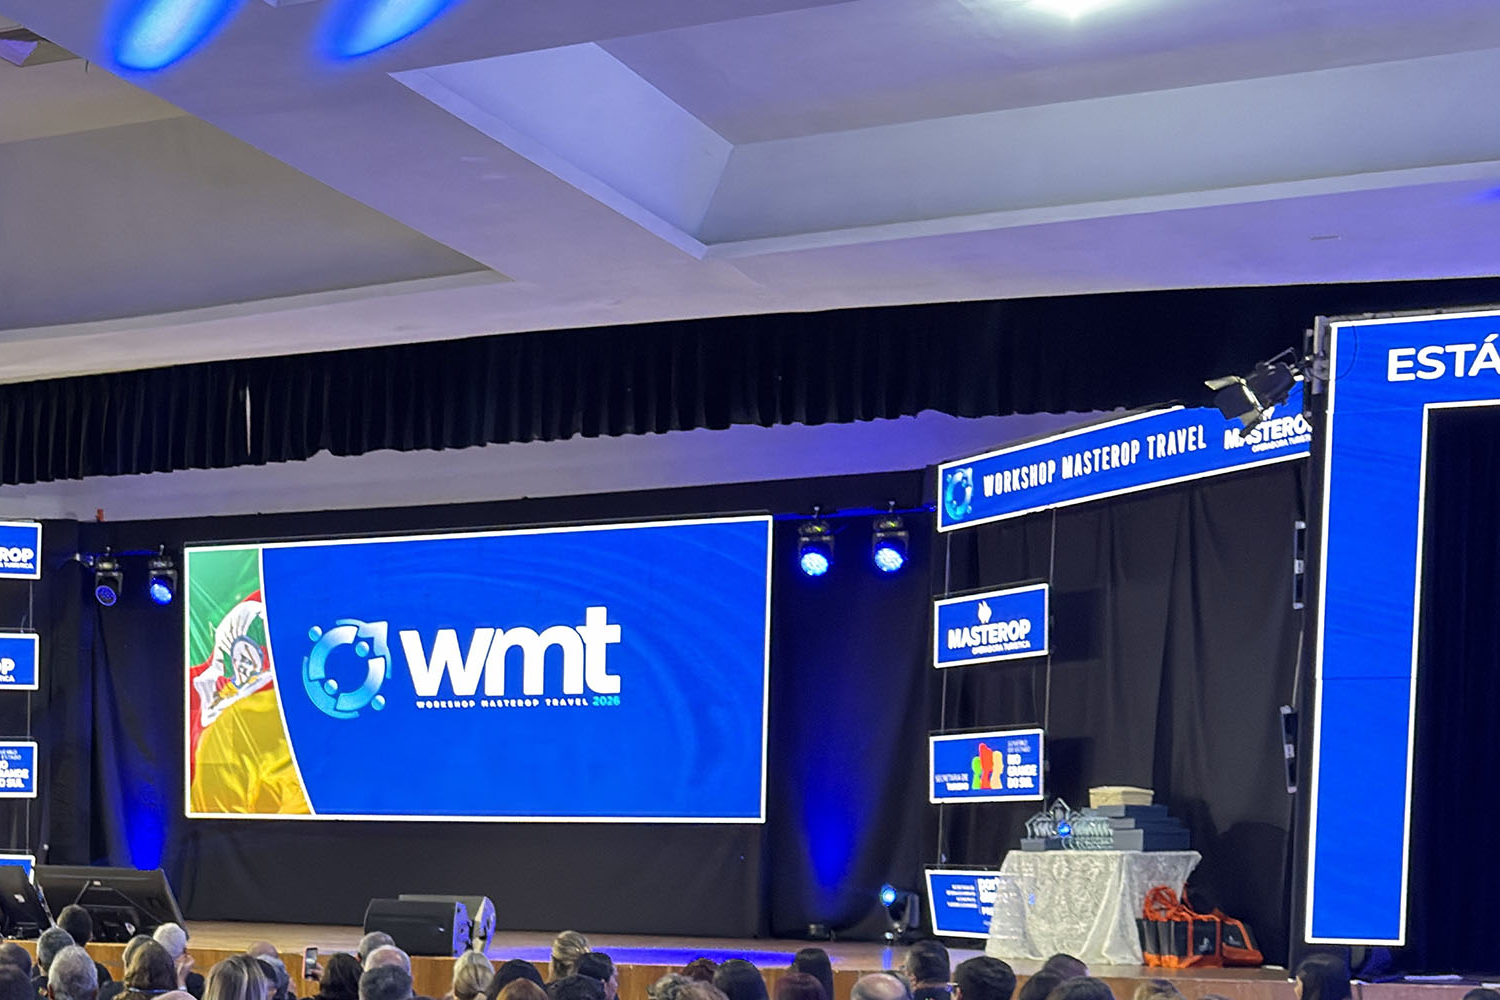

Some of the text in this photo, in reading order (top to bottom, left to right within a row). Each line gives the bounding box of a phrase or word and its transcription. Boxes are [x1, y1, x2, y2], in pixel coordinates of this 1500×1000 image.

[1387, 333, 1500, 382] ESTÁ
[1223, 413, 1312, 450] MSTERO
[983, 424, 1207, 498] WORKSHOP MASTEROP TRAVEL
[399, 606, 622, 697] wmt
[947, 618, 1031, 650] MASTEROP
[416, 695, 621, 709] WORKSHOP MASTEROP TRAVEL 2026
